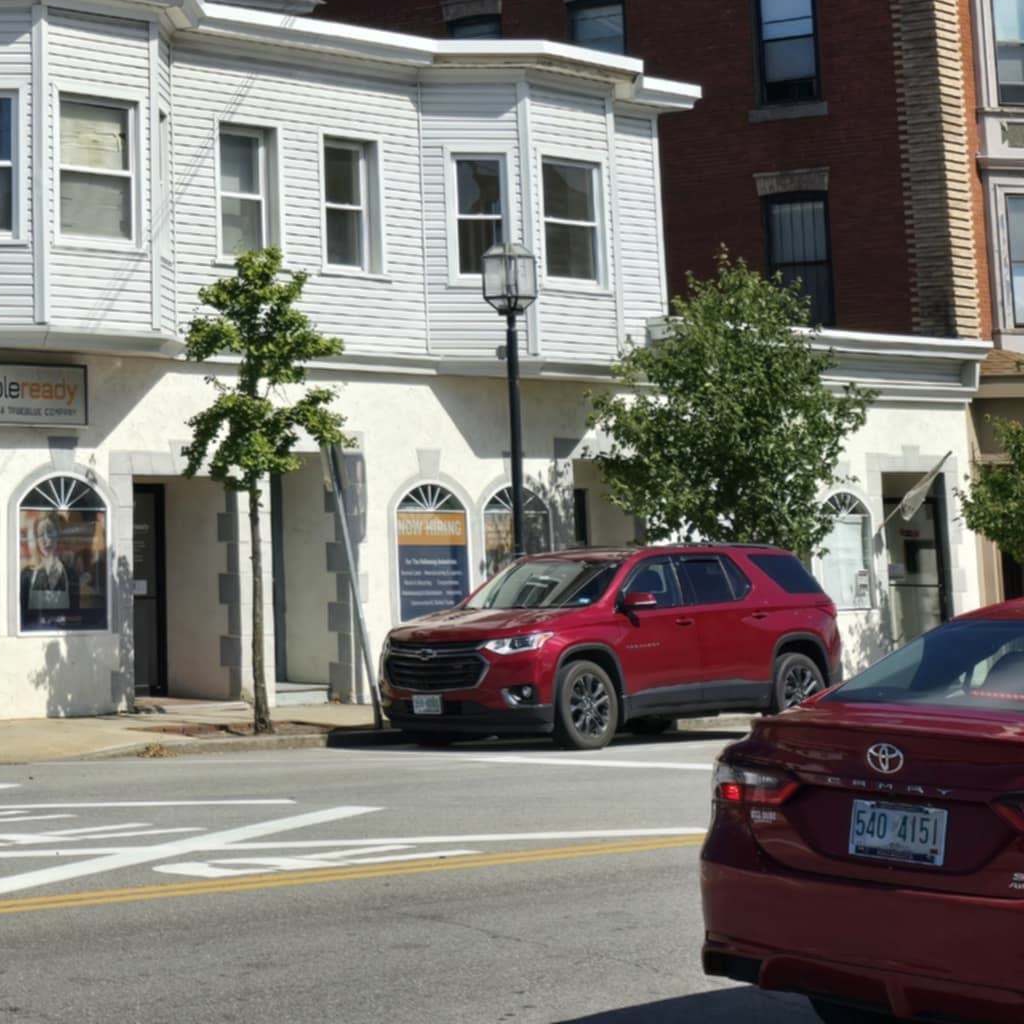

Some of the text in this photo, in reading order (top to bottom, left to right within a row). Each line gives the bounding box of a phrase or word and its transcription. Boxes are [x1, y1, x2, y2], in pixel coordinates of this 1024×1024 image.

[828, 776, 952, 795] CAMRY
[855, 810, 938, 846] 540 4151
